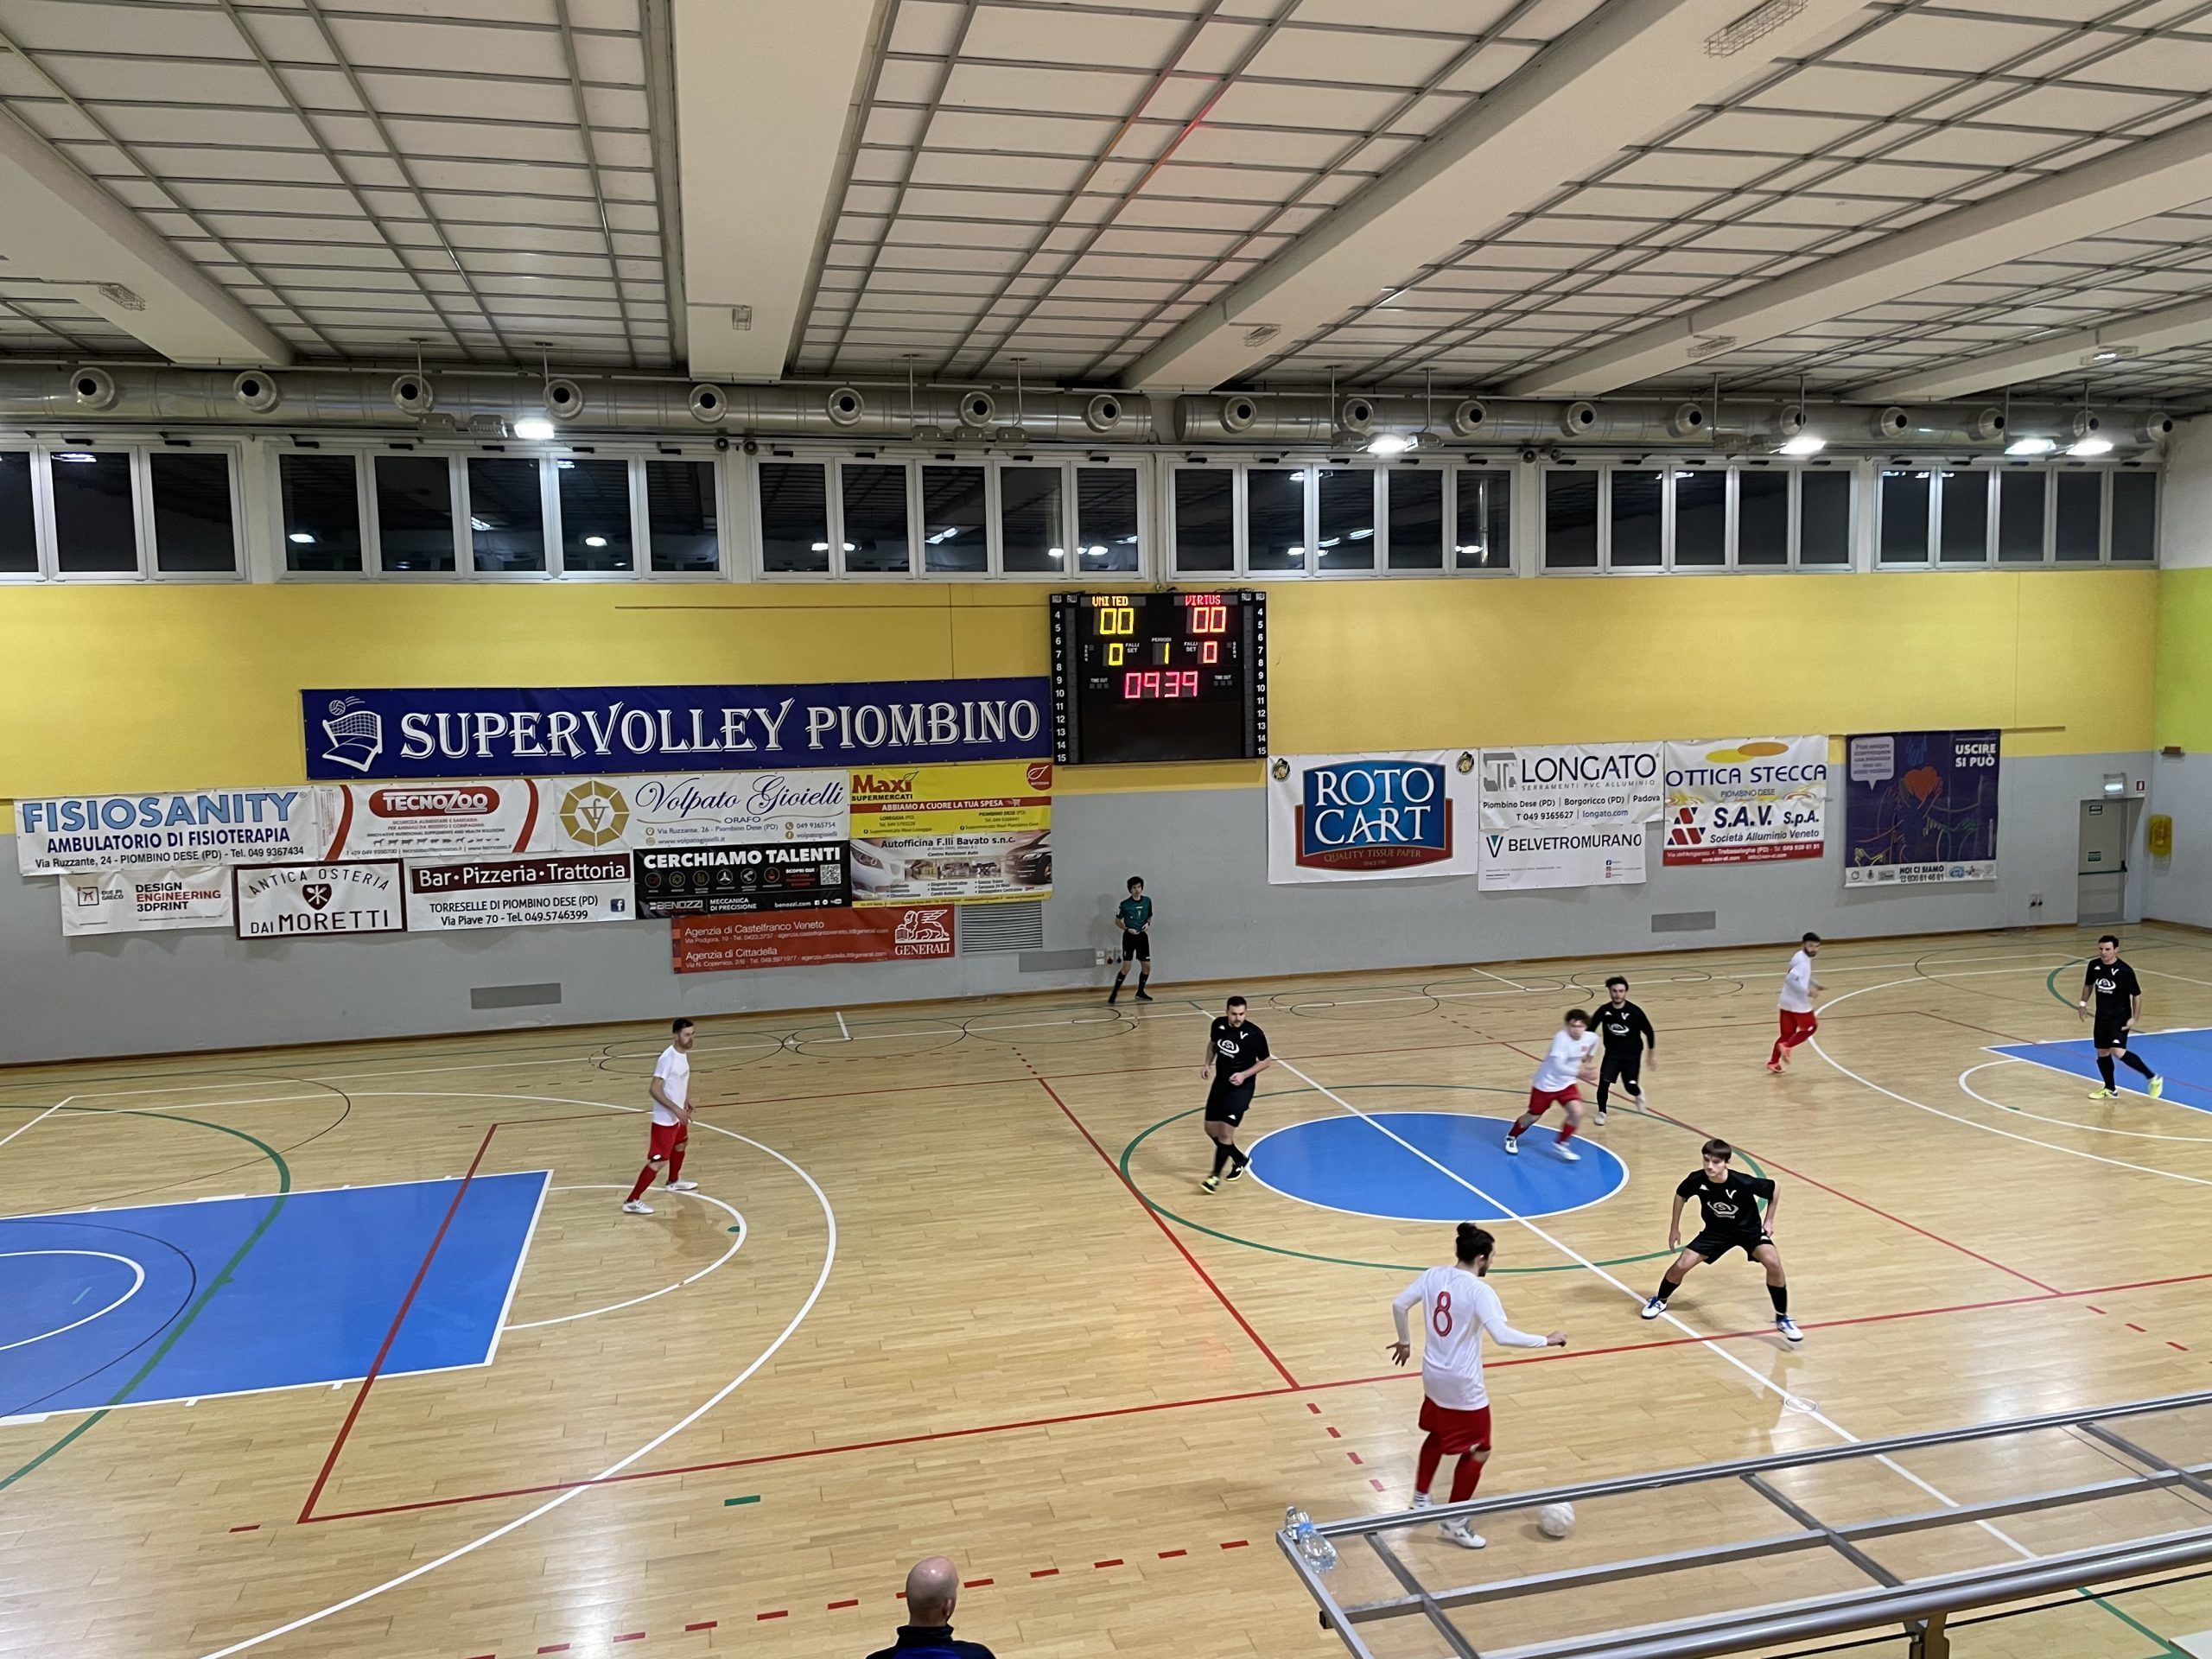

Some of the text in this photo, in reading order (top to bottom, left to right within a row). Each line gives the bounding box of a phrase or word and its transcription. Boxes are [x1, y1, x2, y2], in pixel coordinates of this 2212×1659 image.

[1091, 595, 1128, 607] UNITED
[1100, 607, 1134, 635] 00
[1192, 606, 1226, 633] 00
[1109, 643, 1123, 666] 0
[1164, 643, 1170, 664] 1
[1203, 641, 1217, 664] 0
[400, 698, 1041, 759] SUPERVOLLEY PIOMBINO
[1955, 744, 1996, 754] USCIRE
[1522, 753, 1656, 783] LONGATO
[1955, 754, 1995, 768] SI PUÒ
[852, 771, 913, 794] Maxi
[1666, 764, 1827, 786] OTTICA STECCA
[635, 774, 843, 817] Volpato Gioielli
[1314, 767, 1435, 806] ROTO
[851, 793, 913, 802] SUPERMERCATI
[881, 803, 918, 811] ABBIAMO
[1483, 800, 1518, 809] Piombino
[1539, 799, 1555, 808] (PD)
[1564, 798, 1605, 807] Borgoricco
[1608, 796, 1624, 805] (PD)
[1633, 794, 1661, 803] Padova
[22, 791, 299, 834] FISIOSANITY
[1582, 810, 1629, 819] longato.com
[1314, 805, 1431, 845] CART
[48, 828, 290, 854] AMBULATORIO DI FISIOTERAPIA
[881, 839, 933, 849] Autofficina
[937, 836, 954, 846] F.lli
[957, 836, 989, 845] Bavato
[992, 836, 1016, 844] s.n.c.
[1509, 834, 1642, 851] BELVETROMURANO
[1710, 830, 1820, 843] Società Alluminio Veneto
[35, 846, 304, 869] Via Ruzzante, 24 PIOMBINO DESE (PD) Tel. 049 9367434
[644, 847, 841, 869] CERCHIAMO TALENTI
[1324, 850, 1363, 862] QUALITY
[1396, 849, 1421, 858] PAPER
[249, 868, 390, 896] ANTICA OSTERIA
[420, 861, 626, 887] Bar Pizzeria Trattoria
[136, 882, 182, 893] DESIGN
[136, 890, 221, 902] ENGINEERING
[137, 901, 188, 912] 3DPRINT
[429, 895, 598, 913] TORRESELLE DI PIOMBINO DESE (PD)
[658, 899, 703, 910] BENOZZI
[251, 910, 390, 934] DAI MORETTI
[441, 916, 456, 926] Via
[458, 914, 484, 925] Piave
[486, 914, 499, 924] 70
[685, 927, 721, 938] Agenzia
[734, 924, 791, 934] Castelfranco
[793, 921, 824, 930] Veneto
[685, 951, 722, 962] Agenzia
[735, 947, 778, 957] Cittadella
[894, 943, 950, 956] GENERALI
[1431, 1290, 1453, 1338] 8
